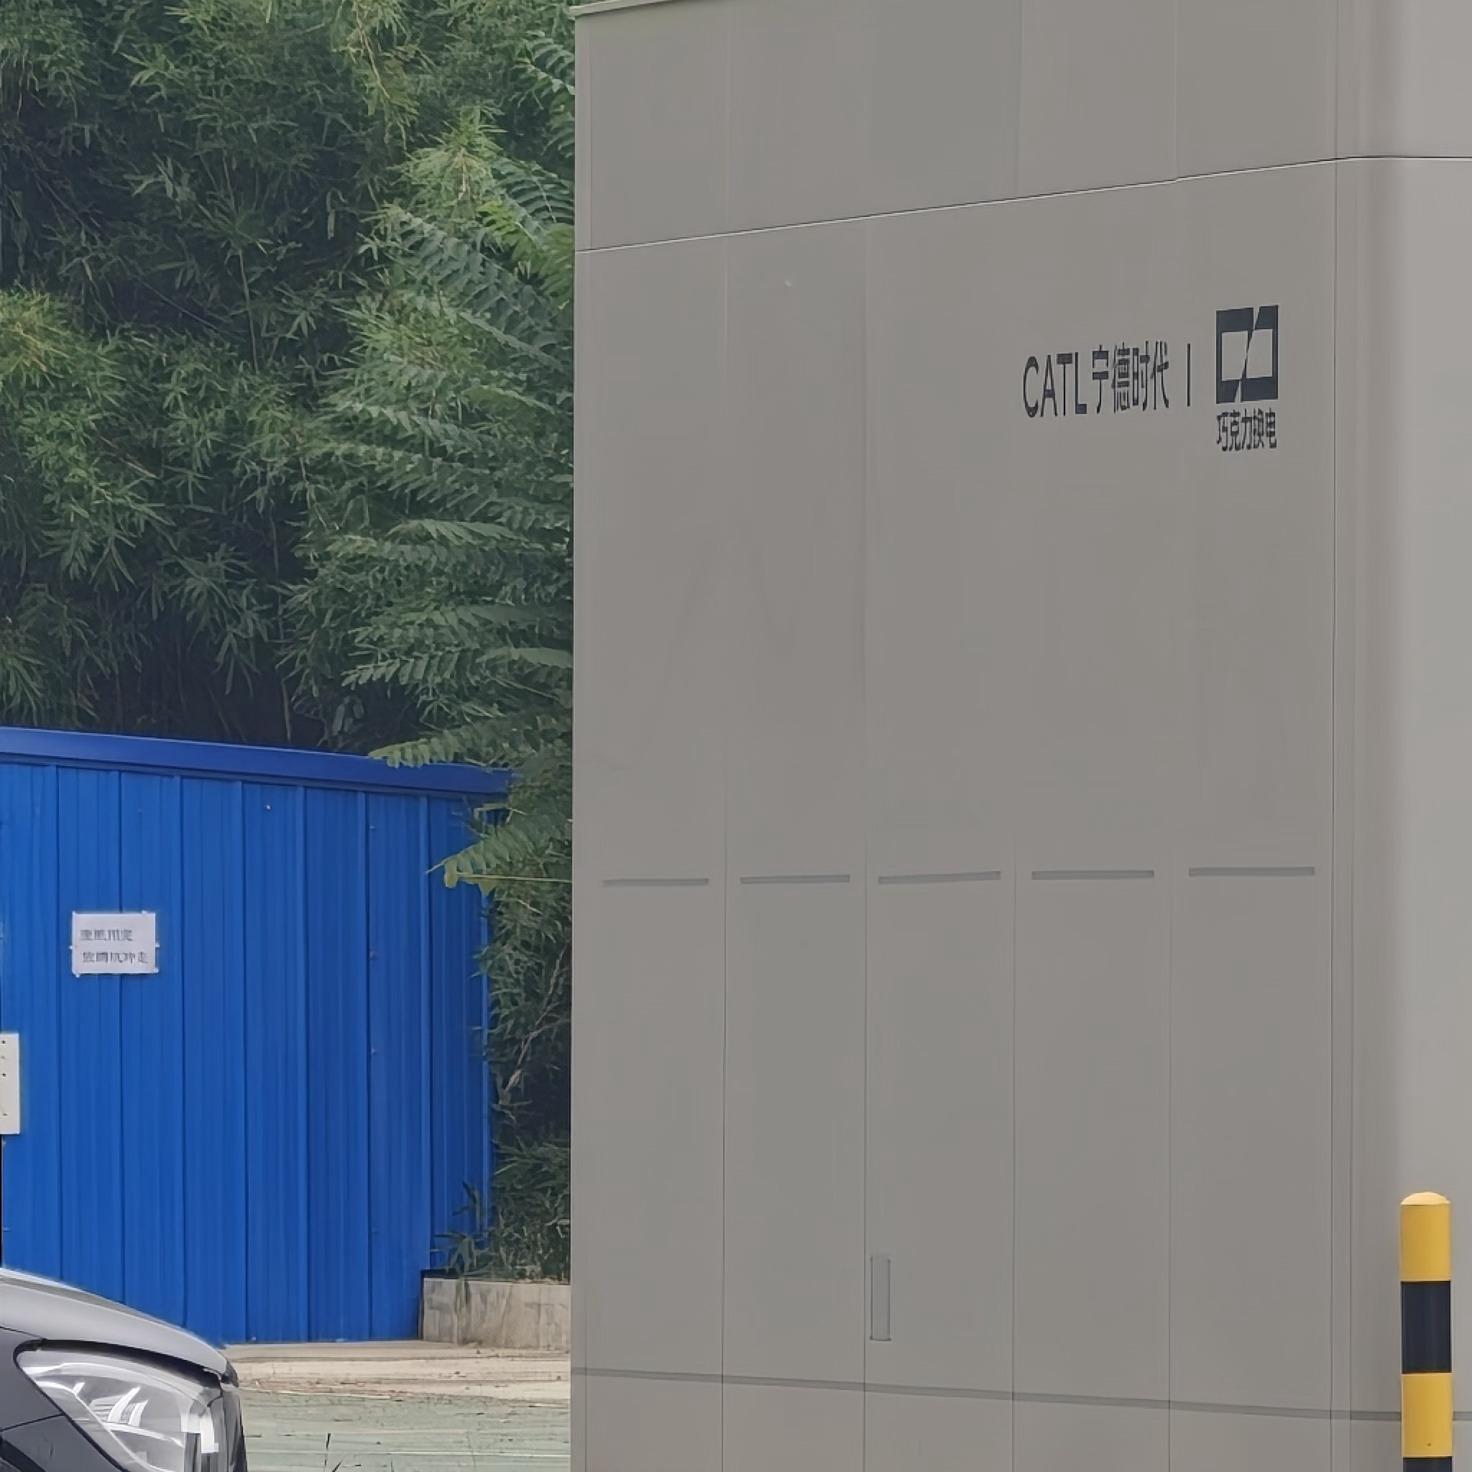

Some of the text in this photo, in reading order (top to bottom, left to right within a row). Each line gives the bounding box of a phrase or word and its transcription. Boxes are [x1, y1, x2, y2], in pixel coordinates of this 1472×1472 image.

[1022, 339, 1170, 418] CATL 宁德时代
[1215, 407, 1279, 452] 巧克力换电
